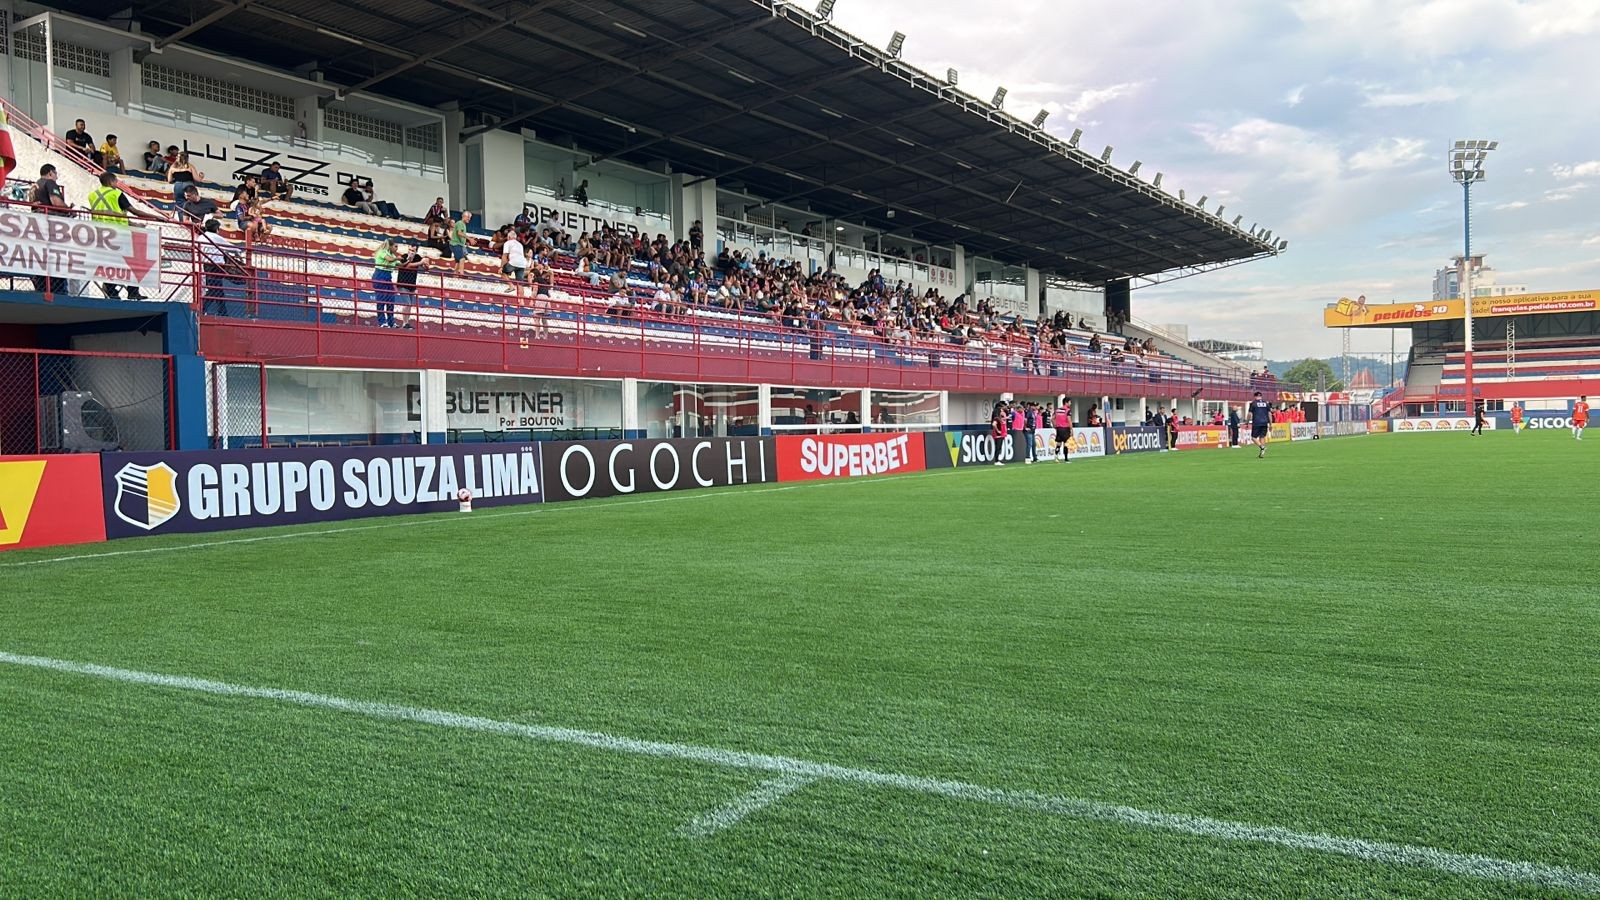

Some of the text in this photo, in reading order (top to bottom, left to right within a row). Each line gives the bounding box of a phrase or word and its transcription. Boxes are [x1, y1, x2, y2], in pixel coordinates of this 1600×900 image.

[0, 213, 121, 251] SABOR
[94, 265, 132, 281] AQUI
[1513, 294, 1549, 304] aplicativo
[1551, 293, 1568, 302] para
[446, 391, 563, 414] BUETTNER
[500, 416, 564, 427] Por BOUTON
[1113, 428, 1161, 452] betnacional
[800, 434, 909, 477] SUPERBET
[560, 439, 766, 497] OGOCHI
[187, 459, 336, 520] GRUPO
[342, 455, 458, 509] SOUZA
